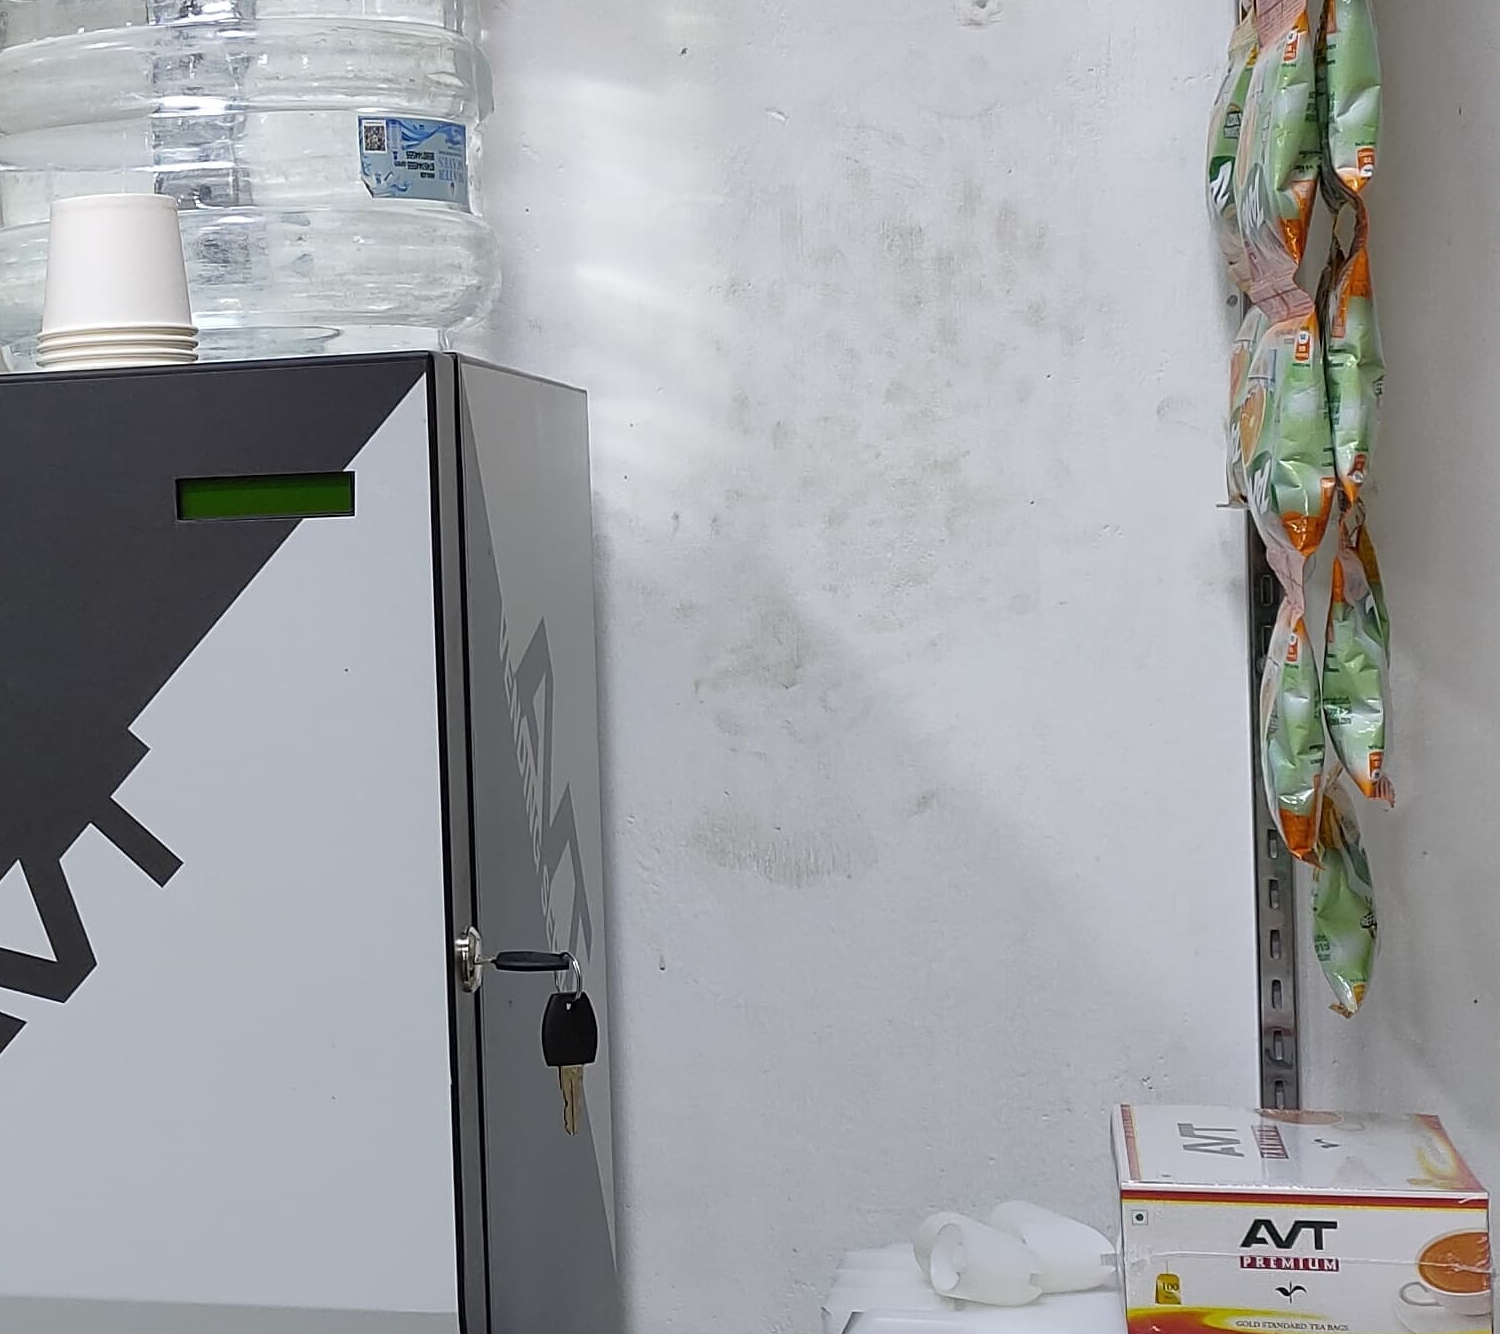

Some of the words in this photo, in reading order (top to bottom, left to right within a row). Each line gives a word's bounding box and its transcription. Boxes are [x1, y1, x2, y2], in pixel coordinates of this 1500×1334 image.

[1177, 1122, 1245, 1158] AVT
[1240, 1218, 1338, 1250] AVT
[1243, 1256, 1338, 1271] PREMIUM
[1162, 1282, 1179, 1291] 100
[1236, 1320, 1260, 1328] GOLD
[1262, 1321, 1307, 1330] STANDARD
[1309, 1323, 1326, 1331] TEA
